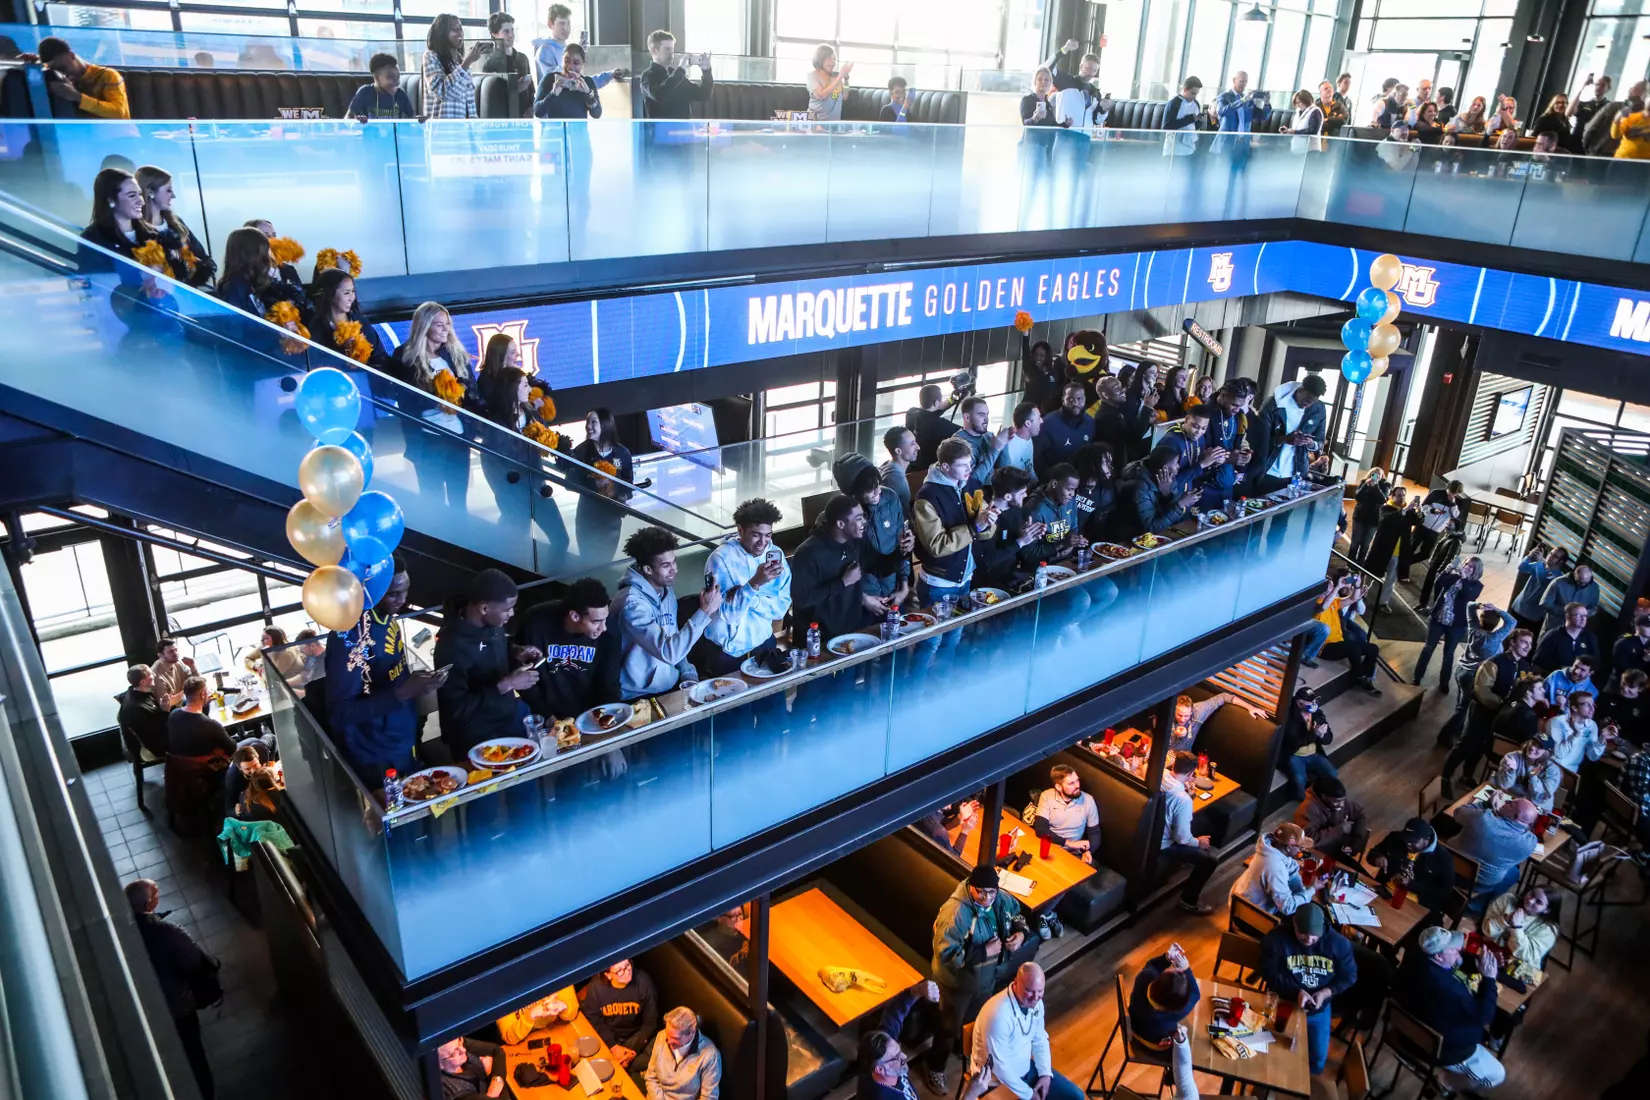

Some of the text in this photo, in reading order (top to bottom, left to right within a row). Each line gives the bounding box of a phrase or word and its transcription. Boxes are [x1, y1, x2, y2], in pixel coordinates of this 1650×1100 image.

[1207, 252, 1235, 293] MU
[1395, 262, 1440, 308] MU
[748, 267, 1121, 345] MARQUETTE GOLDEN EAGLES
[1190, 322, 1223, 356] RESTROOMS
[547, 644, 596, 664] JORDAN
[601, 1001, 640, 1017] ARQUETT
